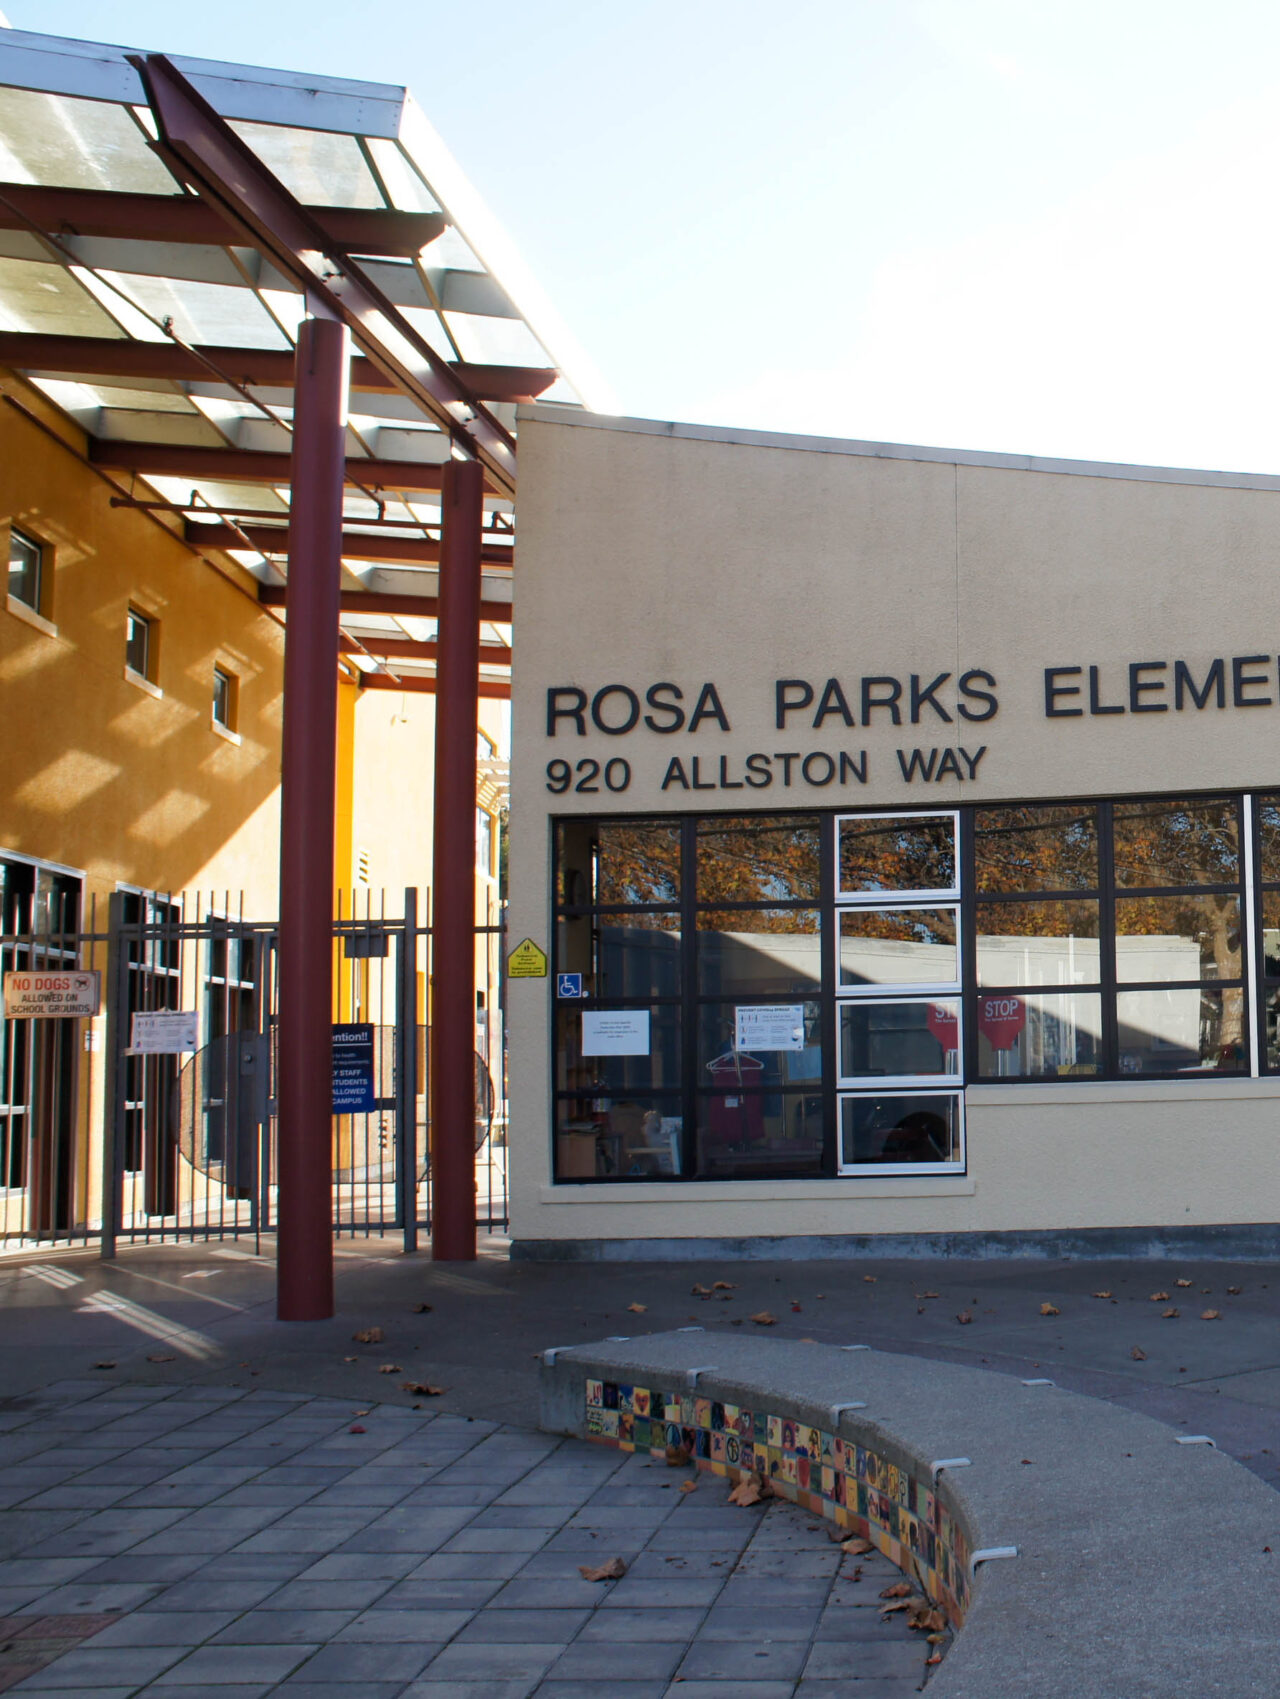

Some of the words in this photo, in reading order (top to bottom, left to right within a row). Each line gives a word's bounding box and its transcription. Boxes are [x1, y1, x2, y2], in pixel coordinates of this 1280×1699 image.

[546, 682, 732, 738] ROSA
[775, 668, 999, 731] PARKS
[546, 757, 632, 794] 920
[660, 749, 869, 791] ALLSTON
[896, 745, 988, 783] WAY
[12, 977, 31, 991] NO
[35, 977, 70, 991] DOGS
[22, 993, 62, 1002] ALLOWED
[65, 993, 78, 1002] ON
[10, 1004, 45, 1014] SCHOOL
[48, 1004, 90, 1013] GROUNDS
[985, 1000, 1018, 1017] STOP
